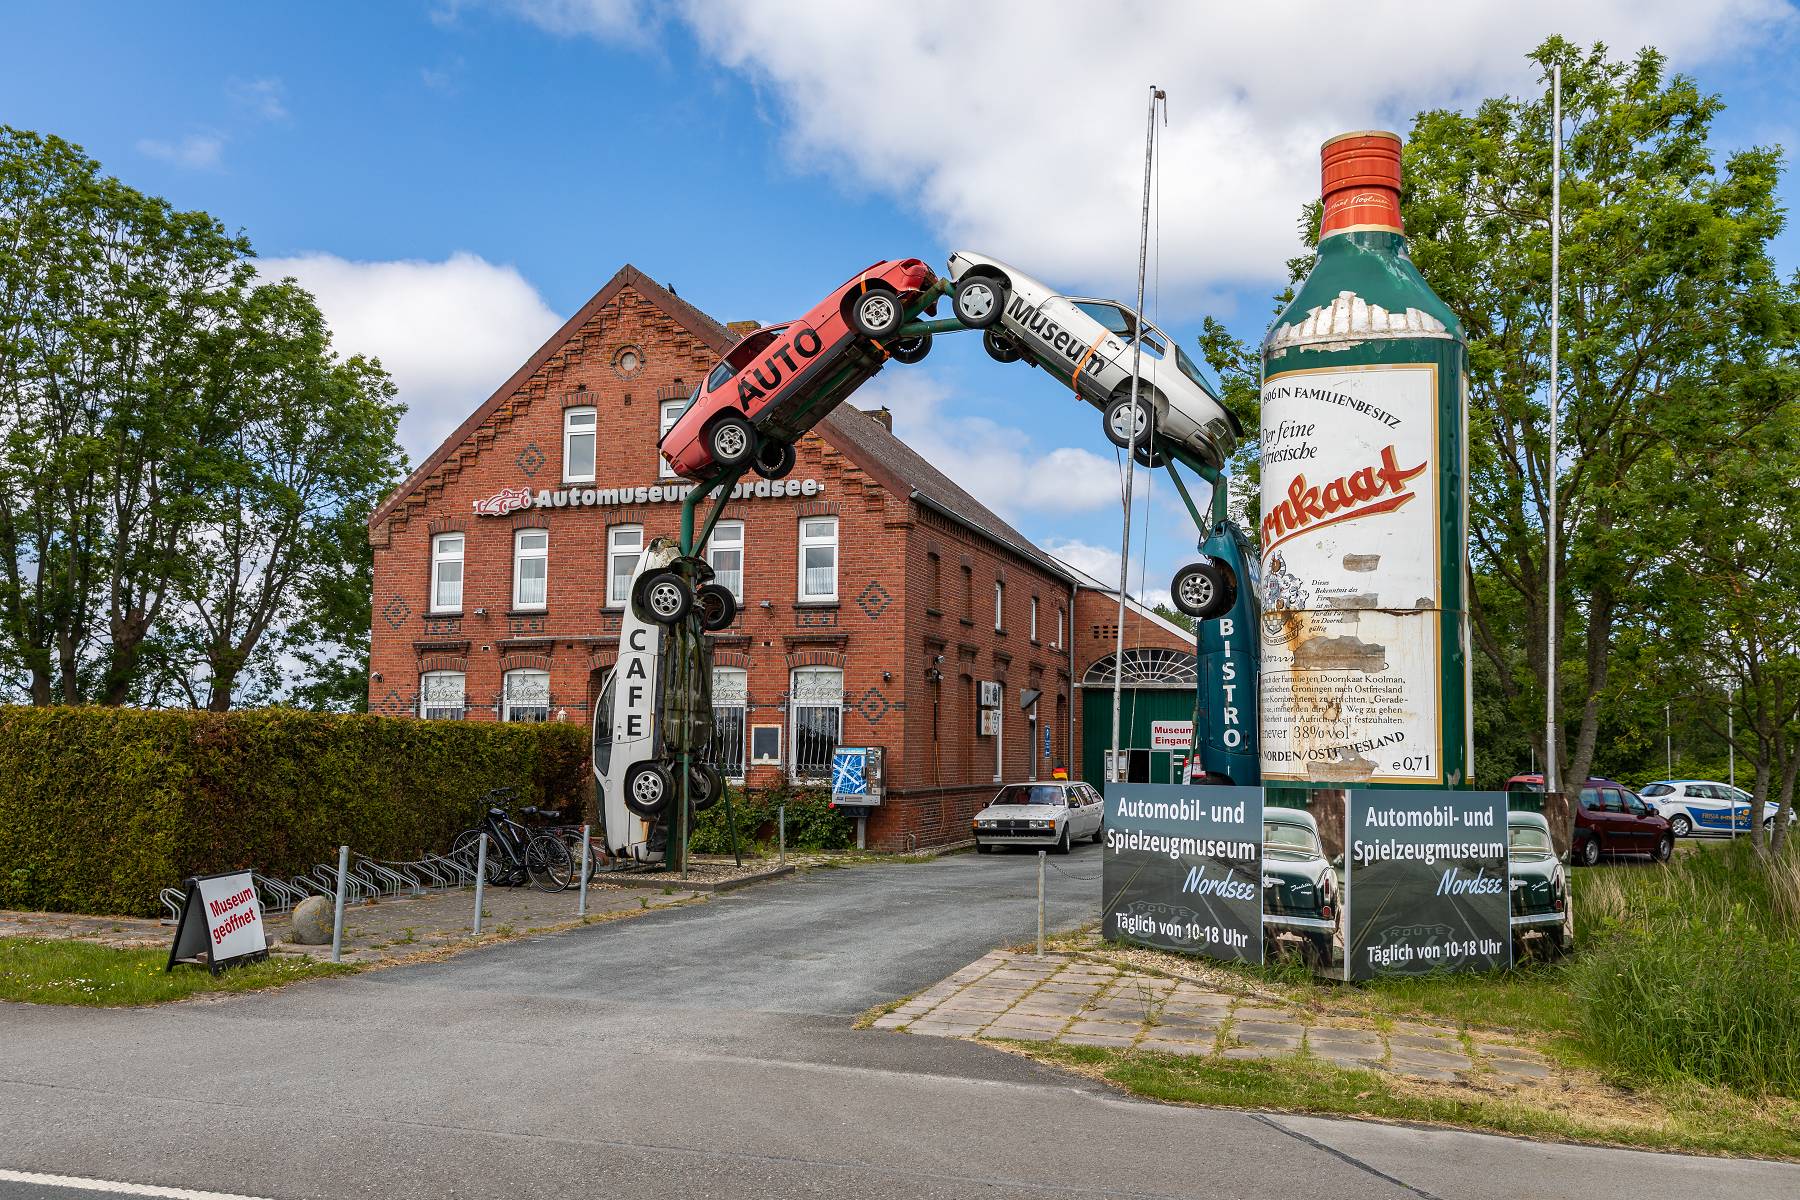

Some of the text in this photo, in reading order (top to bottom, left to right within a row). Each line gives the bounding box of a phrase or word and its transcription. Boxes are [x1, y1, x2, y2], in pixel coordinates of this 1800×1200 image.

[1007, 296, 1105, 377] Museum
[738, 328, 822, 413] AUTO
[1278, 387, 1291, 398] IN
[1294, 387, 1402, 430] FAMILIENBESITZ
[1273, 420, 1315, 446] feine
[1261, 445, 1428, 553] rnkaat
[626, 629, 647, 736] CAFE
[1219, 618, 1241, 747] BISTRO
[1291, 685, 1332, 694] Groningen
[1335, 685, 1352, 693] nach
[1354, 685, 1403, 693] Ostfriesland
[1346, 705, 1364, 715] Weg
[1378, 706, 1403, 715] gehen
[1262, 729, 1288, 739] never
[1117, 797, 1245, 824] Automobil- und
[1365, 806, 1494, 827] Automobil- und
[1107, 828, 1256, 861] Spielzeugmuseum
[1353, 839, 1504, 866] Spielzeugmuseum
[1182, 865, 1255, 901] Nordsee
[1436, 867, 1503, 896] Nordsee
[210, 887, 254, 918] Museum
[1136, 904, 1188, 917] ROUTE
[212, 907, 256, 945] geöffnet
[1115, 912, 1248, 948] Täglich von 10-18 Uhr
[1390, 927, 1446, 937] ROUTE
[1366, 938, 1502, 966] Täglich von 10-18 Uhr
